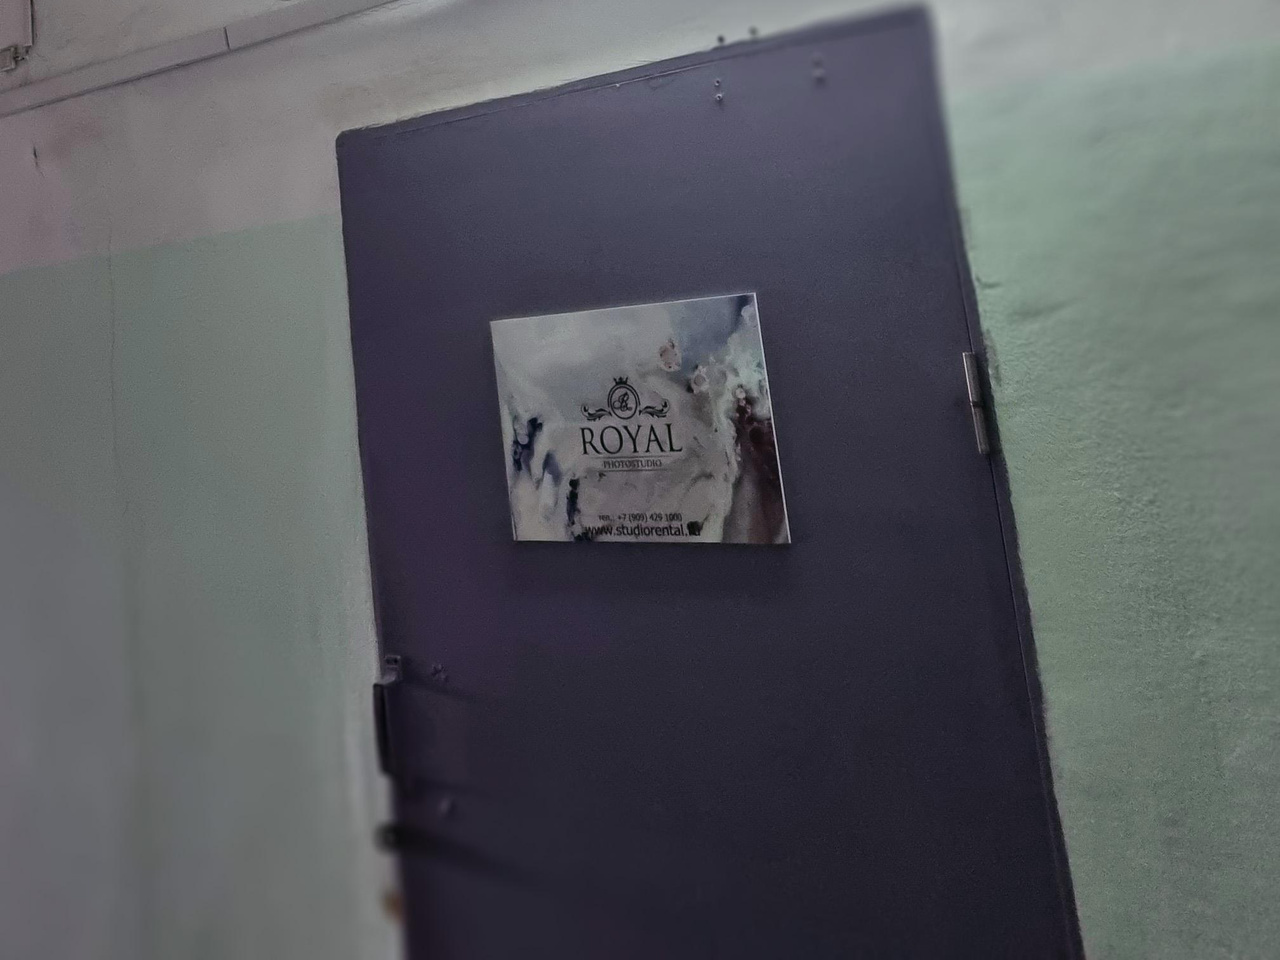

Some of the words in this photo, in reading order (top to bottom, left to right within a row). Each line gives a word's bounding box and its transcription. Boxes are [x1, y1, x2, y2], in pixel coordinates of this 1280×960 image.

[580, 422, 683, 455] ROYAL
[602, 458, 663, 470] PHOTOSTUDIO
[628, 512, 648, 523] (909)
[649, 513, 663, 522] 429
[665, 512, 683, 522] 1000
